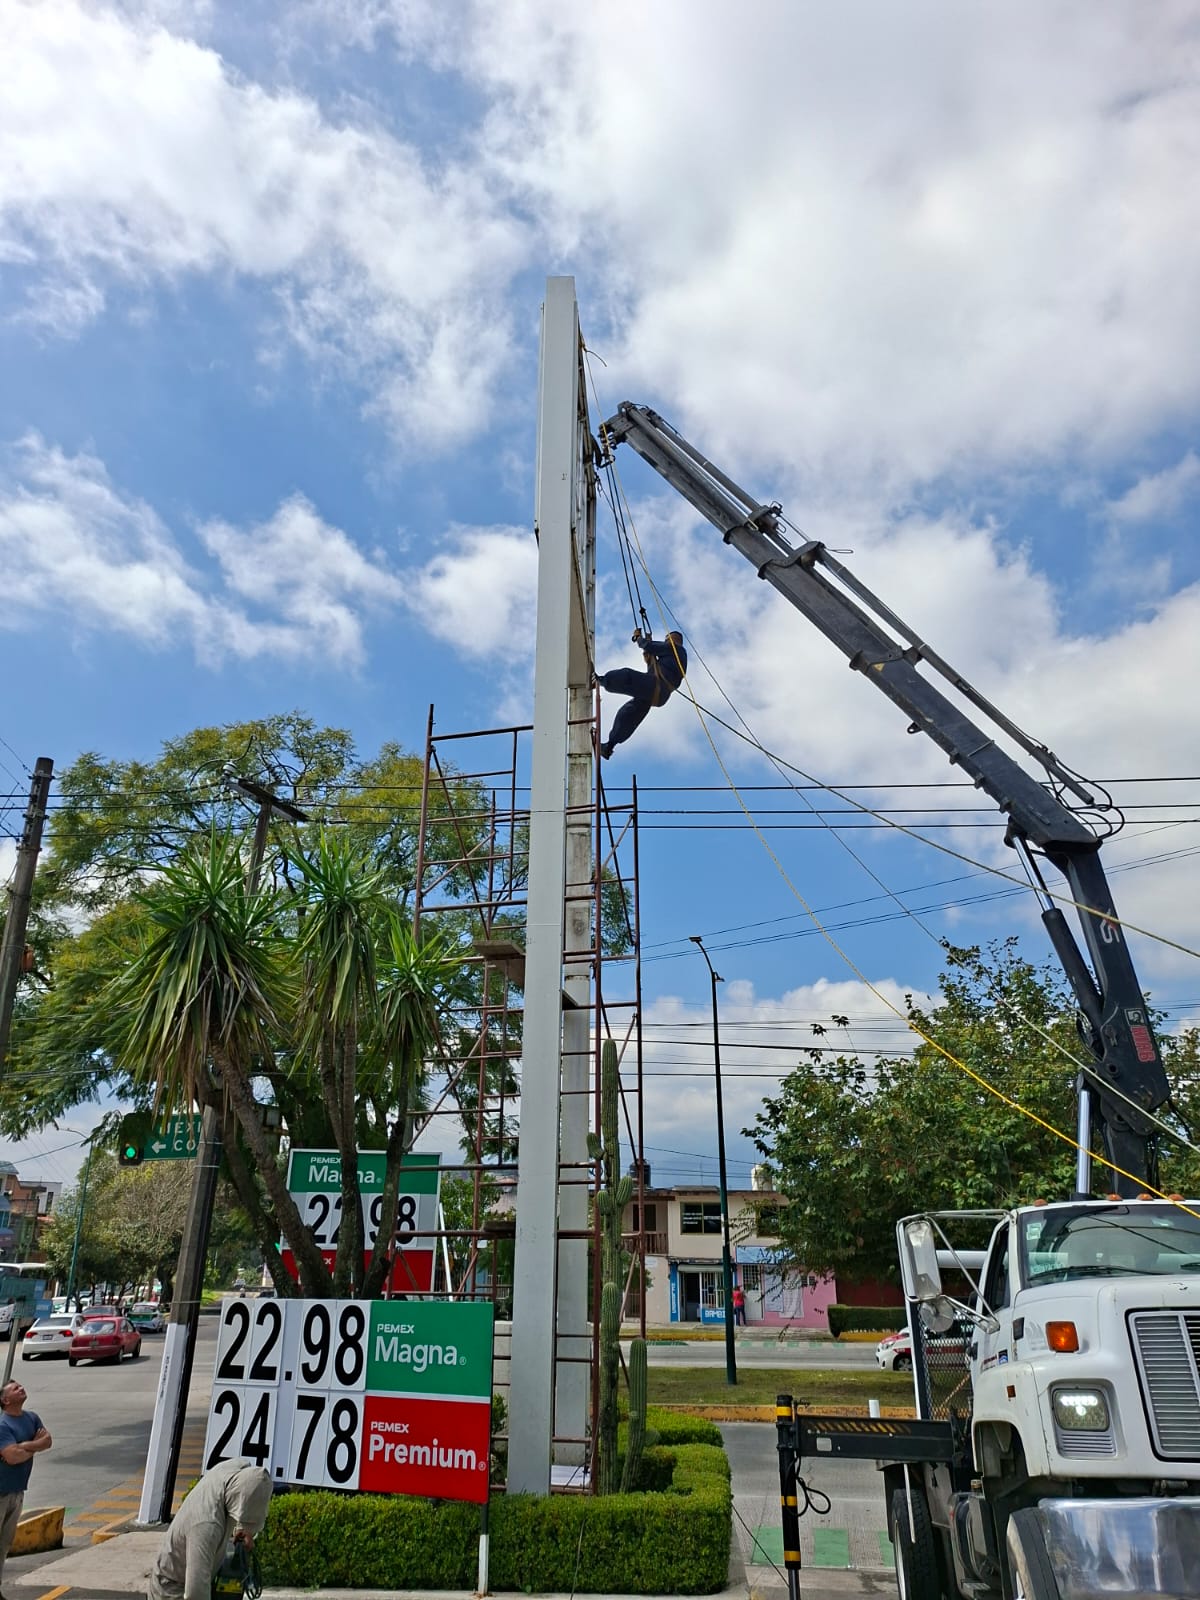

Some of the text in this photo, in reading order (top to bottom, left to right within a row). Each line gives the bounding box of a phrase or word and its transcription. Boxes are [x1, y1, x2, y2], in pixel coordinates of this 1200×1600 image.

[1130, 1025, 1156, 1063] HIAB
[174, 1139, 200, 1151] CO
[310, 1156, 342, 1164] PEMEX
[308, 1164, 375, 1187] Mana
[376, 1323, 415, 1335] PEMEX
[217, 1301, 365, 1386] 22.98
[370, 1420, 410, 1434] PEMEX
[206, 1390, 359, 1484] 24.78
